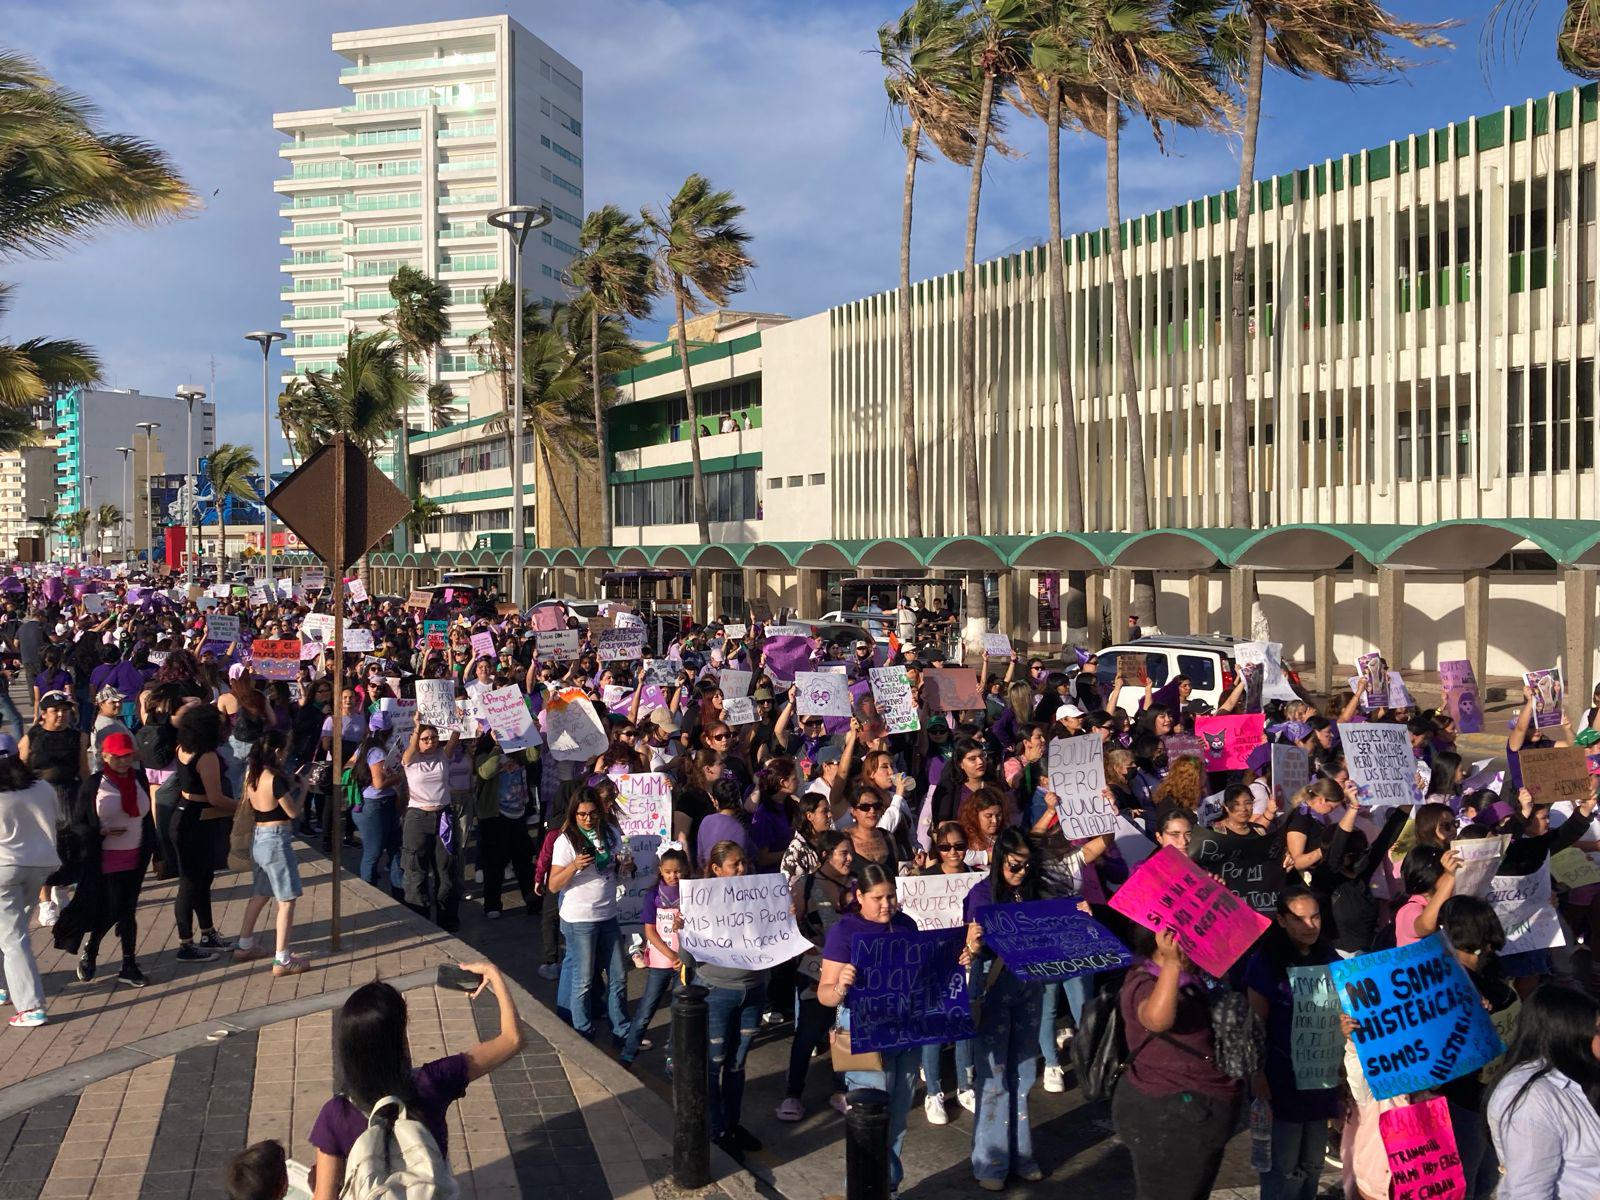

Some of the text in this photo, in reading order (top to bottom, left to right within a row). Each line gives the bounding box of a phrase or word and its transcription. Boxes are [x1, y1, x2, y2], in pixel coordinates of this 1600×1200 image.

[1346, 730, 1380, 743] USTEDES
[1357, 743, 1403, 755] SER MACHOS
[1354, 756, 1372, 768] PERO
[1051, 769, 1098, 796] PERO
[1374, 783, 1405, 798] HUEVOS
[1058, 796, 1116, 816] NUNCA
[660, 818, 666, 828] A
[681, 886, 712, 906] HOY
[902, 880, 926, 896] NO
[904, 895, 960, 912] MUJER
[684, 916, 710, 932] MIS
[1345, 954, 1453, 1012] NO SOMOS
[1367, 1039, 1430, 1077] SOMOS
